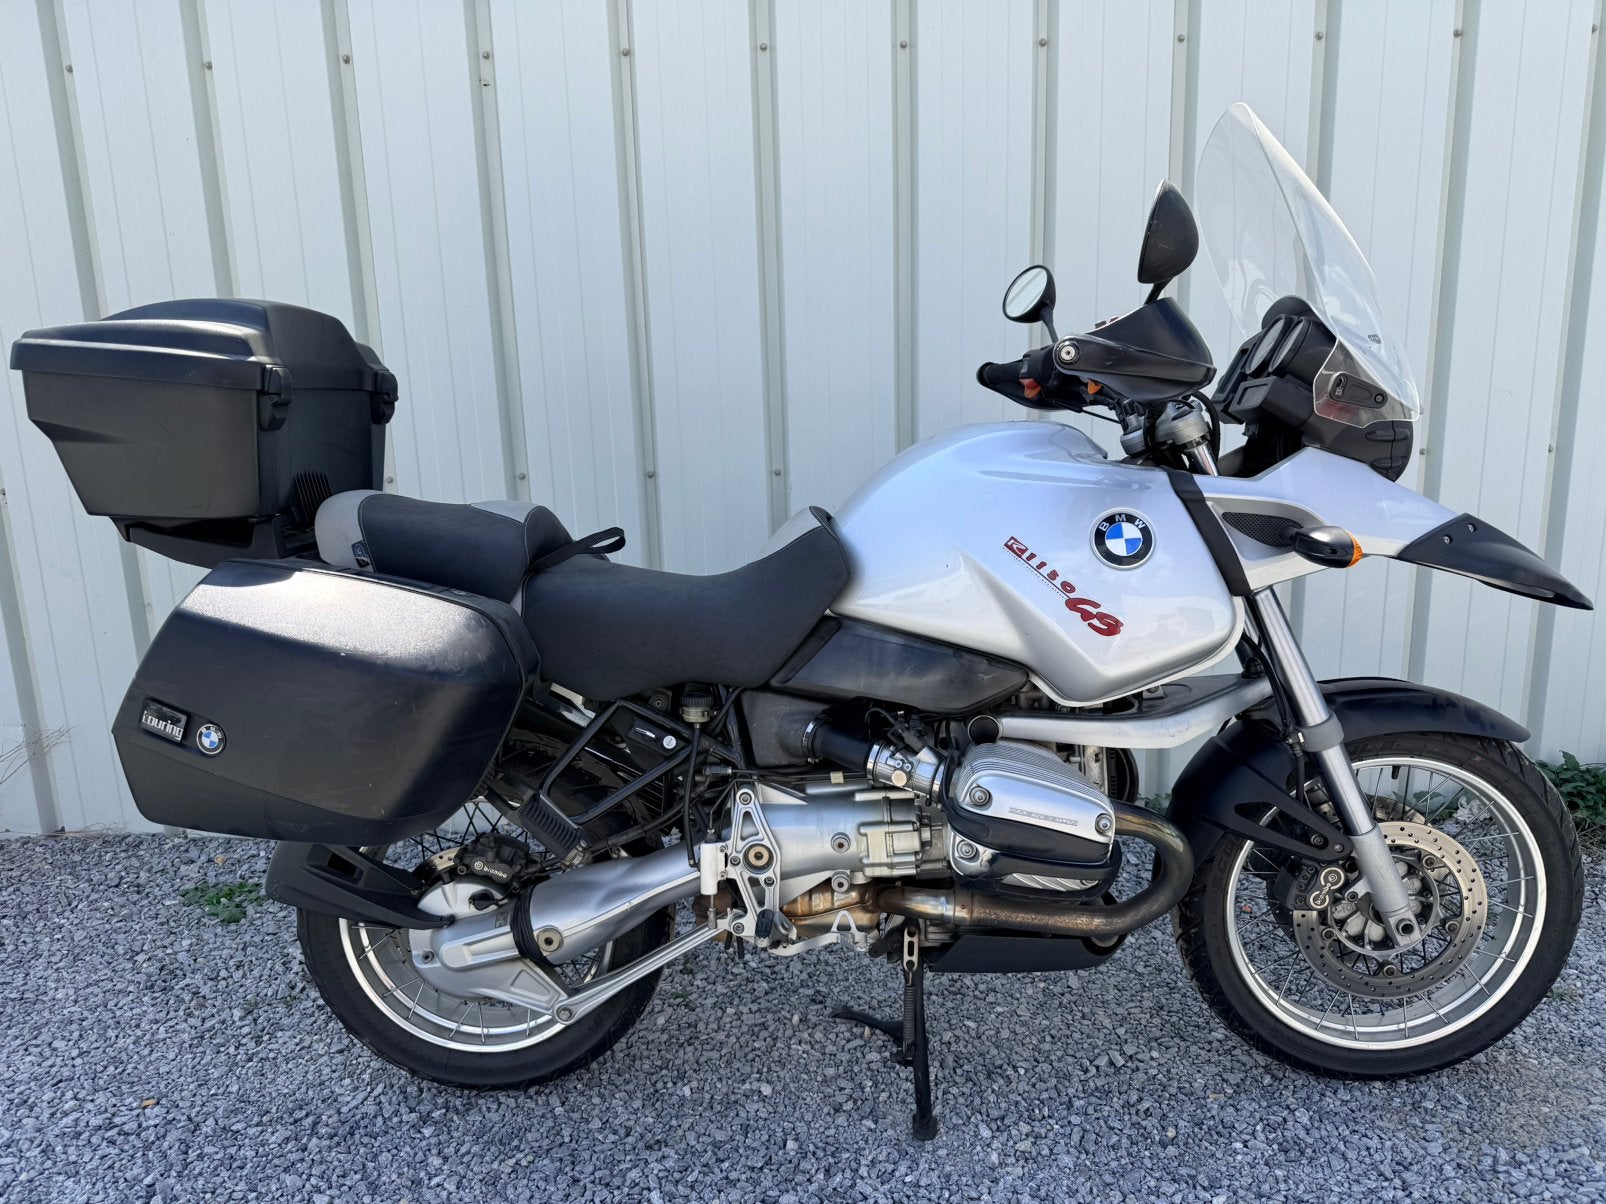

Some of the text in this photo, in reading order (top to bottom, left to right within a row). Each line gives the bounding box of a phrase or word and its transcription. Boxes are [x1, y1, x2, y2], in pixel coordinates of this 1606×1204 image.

[1099, 513, 1146, 532] BMW
[1065, 597, 1124, 637] GS
[142, 710, 184, 741] touring
[483, 864, 508, 878] brembo
